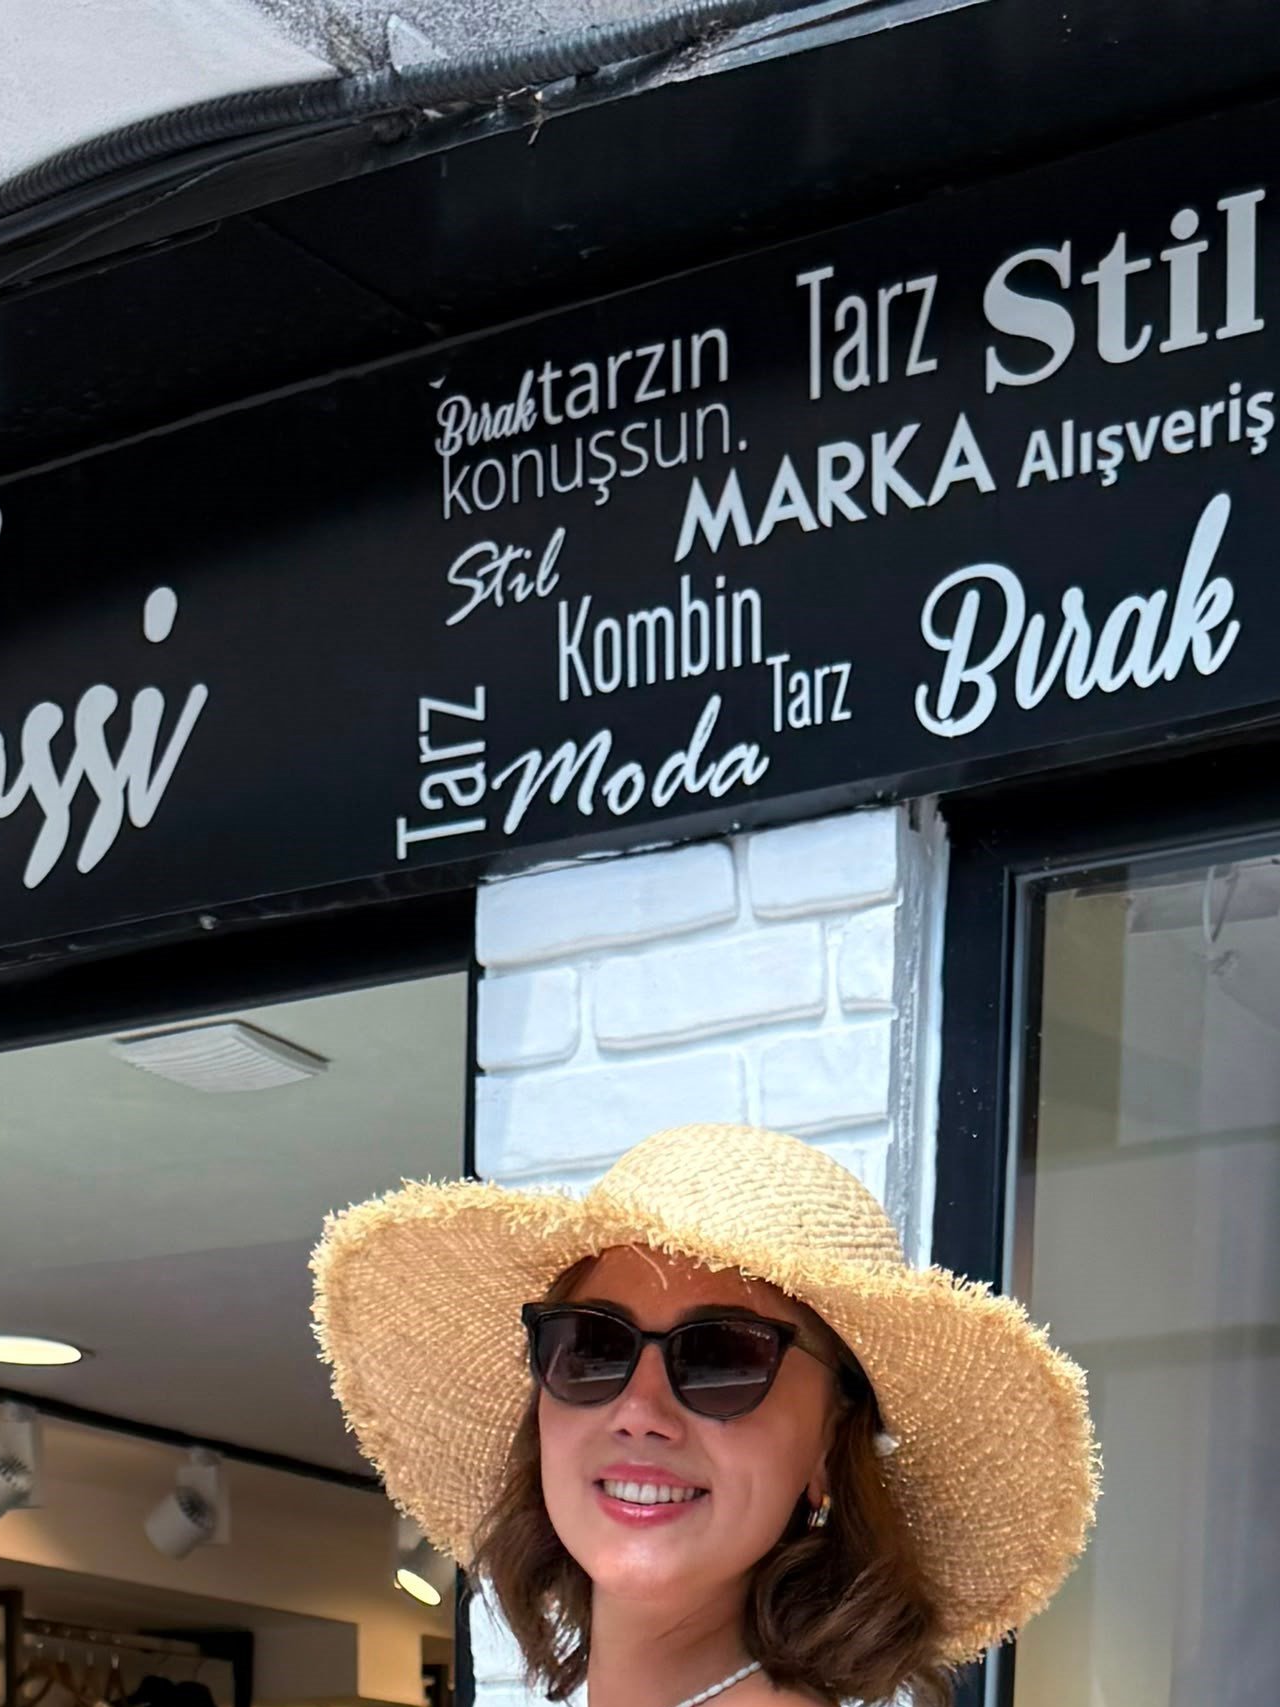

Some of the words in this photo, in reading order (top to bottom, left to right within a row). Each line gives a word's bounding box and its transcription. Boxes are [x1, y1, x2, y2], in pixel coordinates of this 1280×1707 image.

[797, 266, 936, 399] Tarz
[983, 189, 1265, 394] Stil
[433, 368, 538, 456] Bırak
[538, 328, 727, 424] tarzın
[1017, 382, 1274, 487] Alışveriş
[441, 400, 748, 521] konuşsun.
[674, 410, 995, 561] MARKA
[445, 527, 565, 625] Stil
[558, 574, 761, 700] Kombin
[914, 492, 1240, 737] Bırak
[765, 653, 851, 732] Tarz
[396, 685, 485, 859] Tarz
[491, 694, 769, 834] Moda
